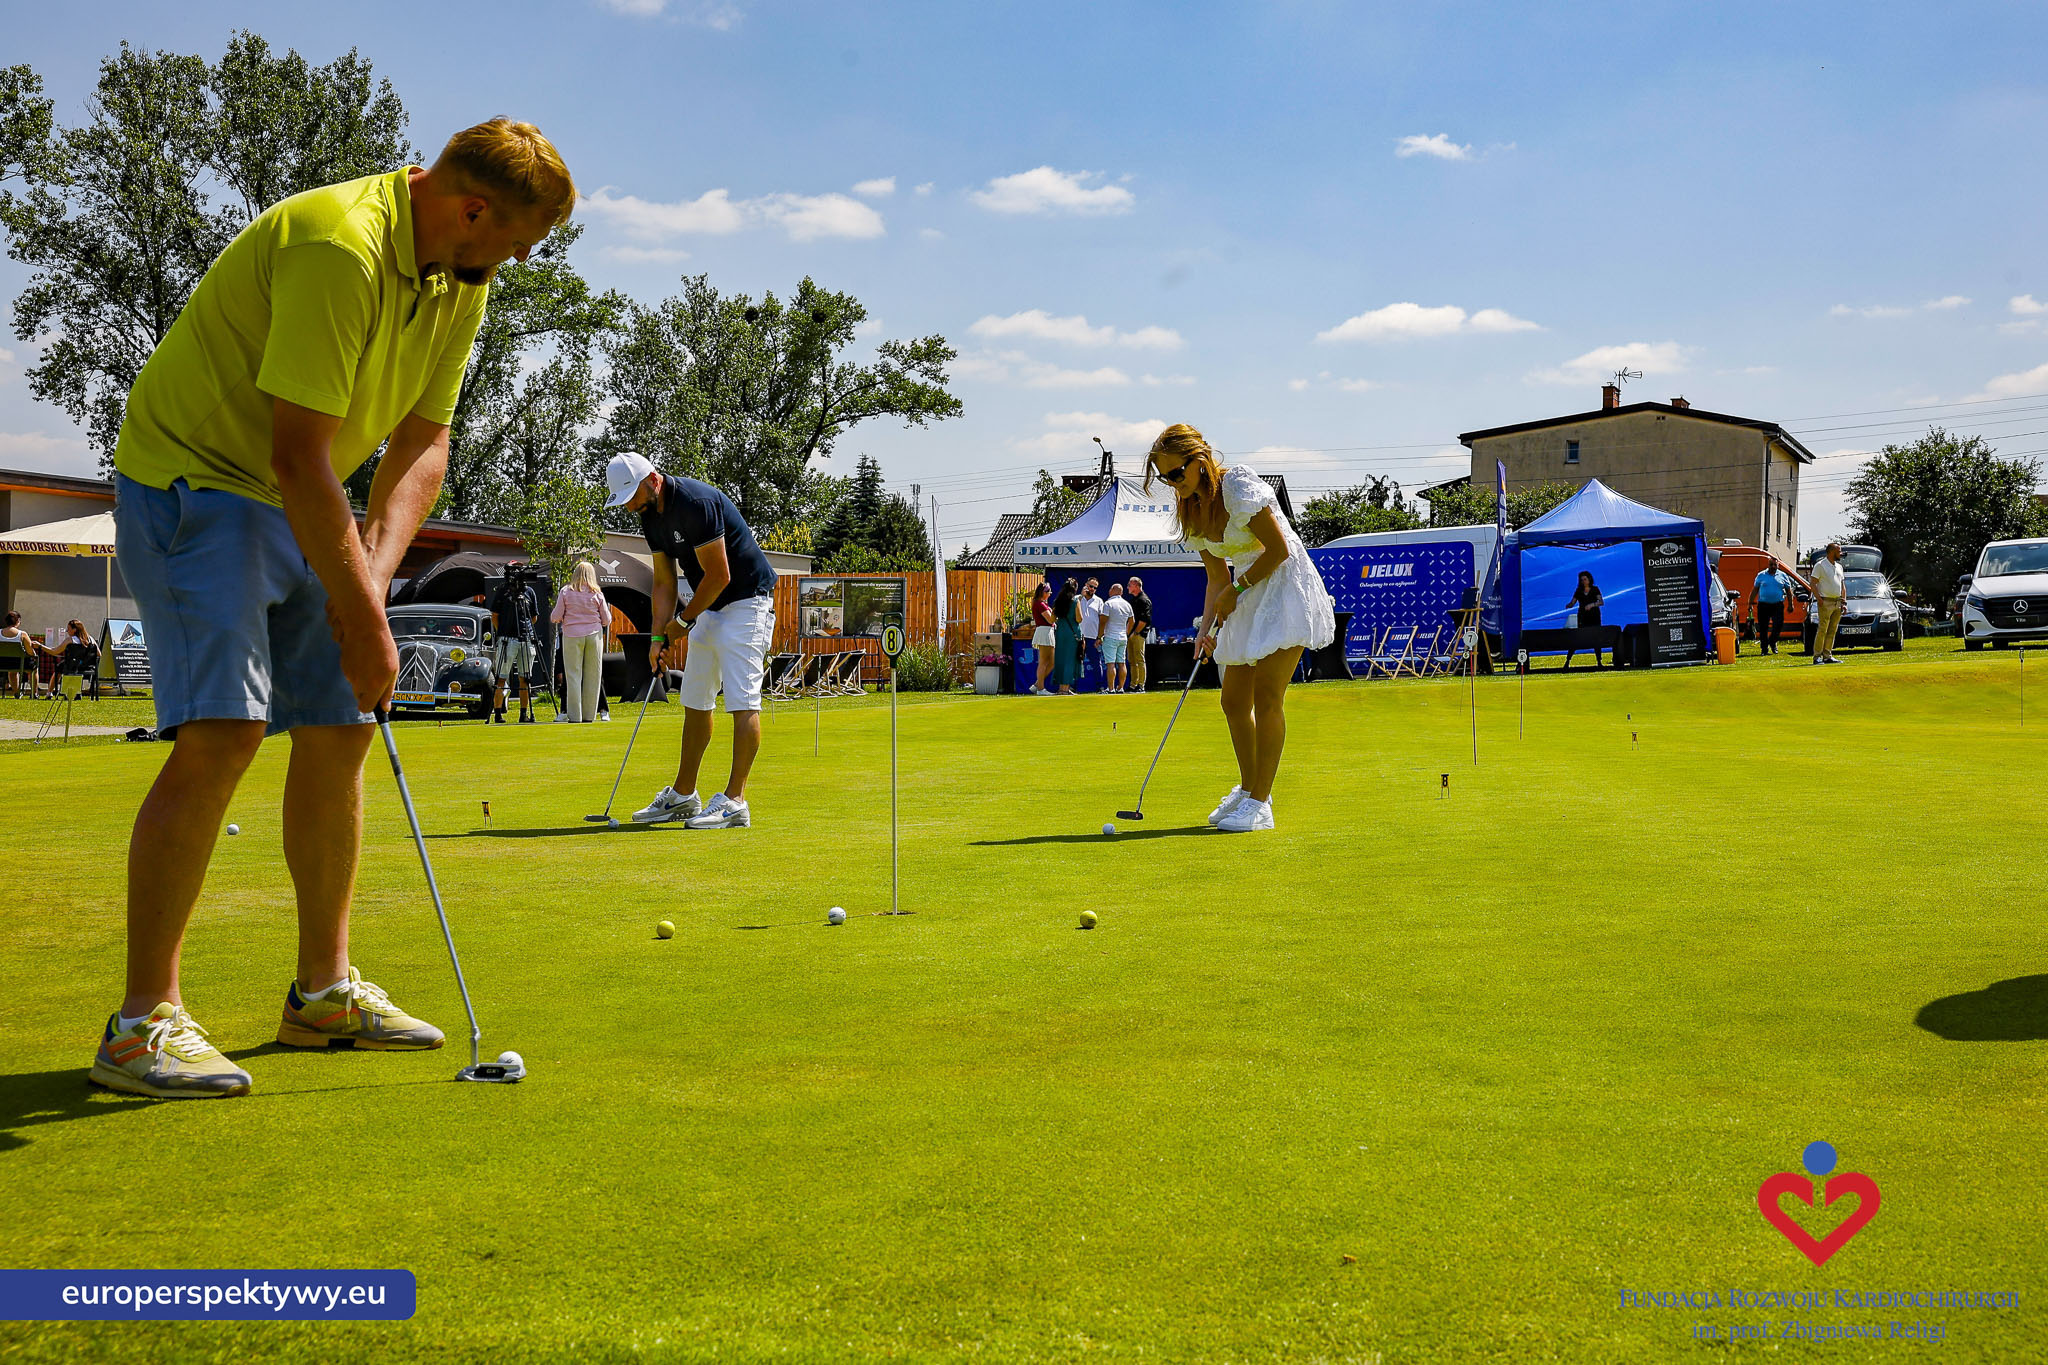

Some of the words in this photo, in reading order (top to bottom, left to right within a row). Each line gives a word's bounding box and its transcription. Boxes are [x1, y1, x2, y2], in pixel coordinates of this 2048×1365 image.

[1118, 503, 1179, 513] JELU
[0, 541, 70, 553] RACIBORSKIE
[91, 545, 115, 554] RAC
[1018, 546, 1079, 555] JELUX
[1098, 543, 1195, 555] WWW.JELUX.
[1648, 557, 1692, 566] Deli&Wine
[1369, 563, 1414, 578] JELUX
[888, 630, 895, 651] 8
